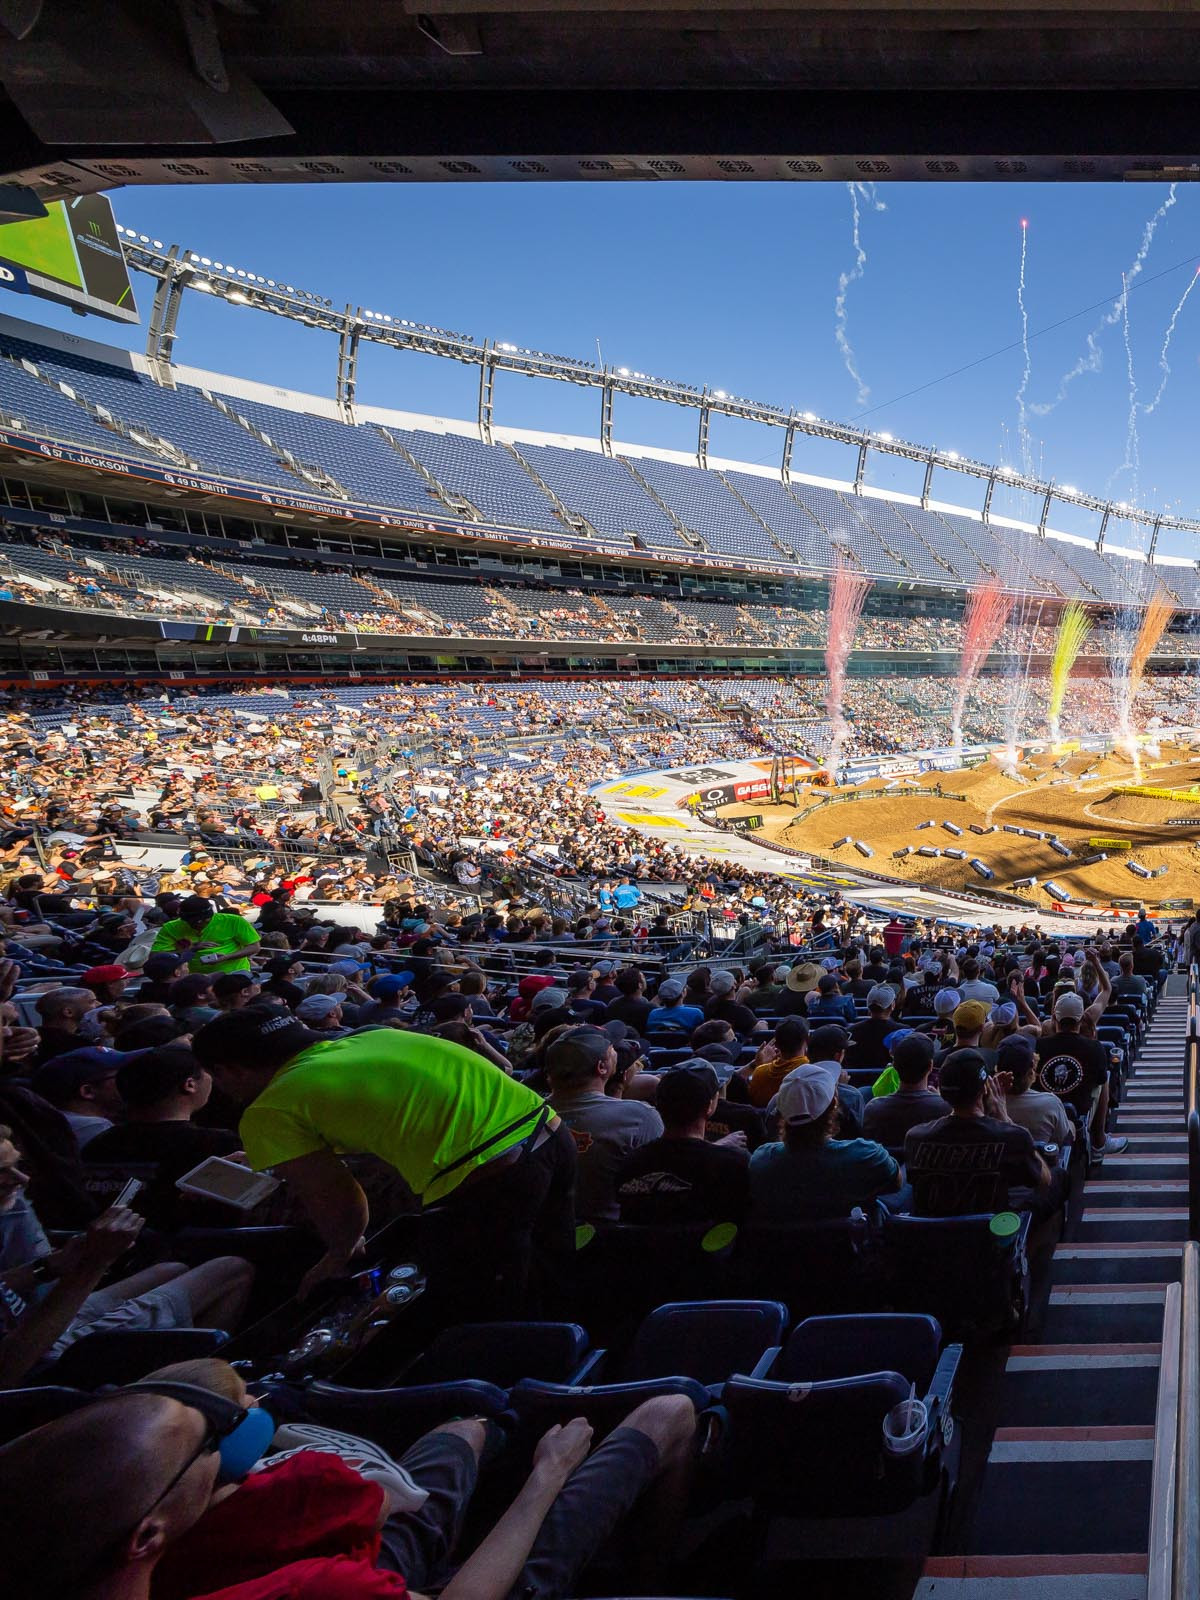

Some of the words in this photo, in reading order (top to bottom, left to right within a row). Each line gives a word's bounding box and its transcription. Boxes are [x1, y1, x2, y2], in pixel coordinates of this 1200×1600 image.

[52, 449, 63, 458] 57
[67, 452, 76, 461] T.
[77, 455, 129, 473] JACKSON
[177, 477, 189, 486] 49
[200, 483, 228, 495] SMITH
[275, 497, 287, 506] 65
[289, 499, 342, 516] ZIMMERMAN
[403, 520, 425, 529] DAVIS
[484, 533, 509, 541] SMITH
[550, 541, 573, 549] MINGO
[301, 634, 338, 644] 4:48PM
